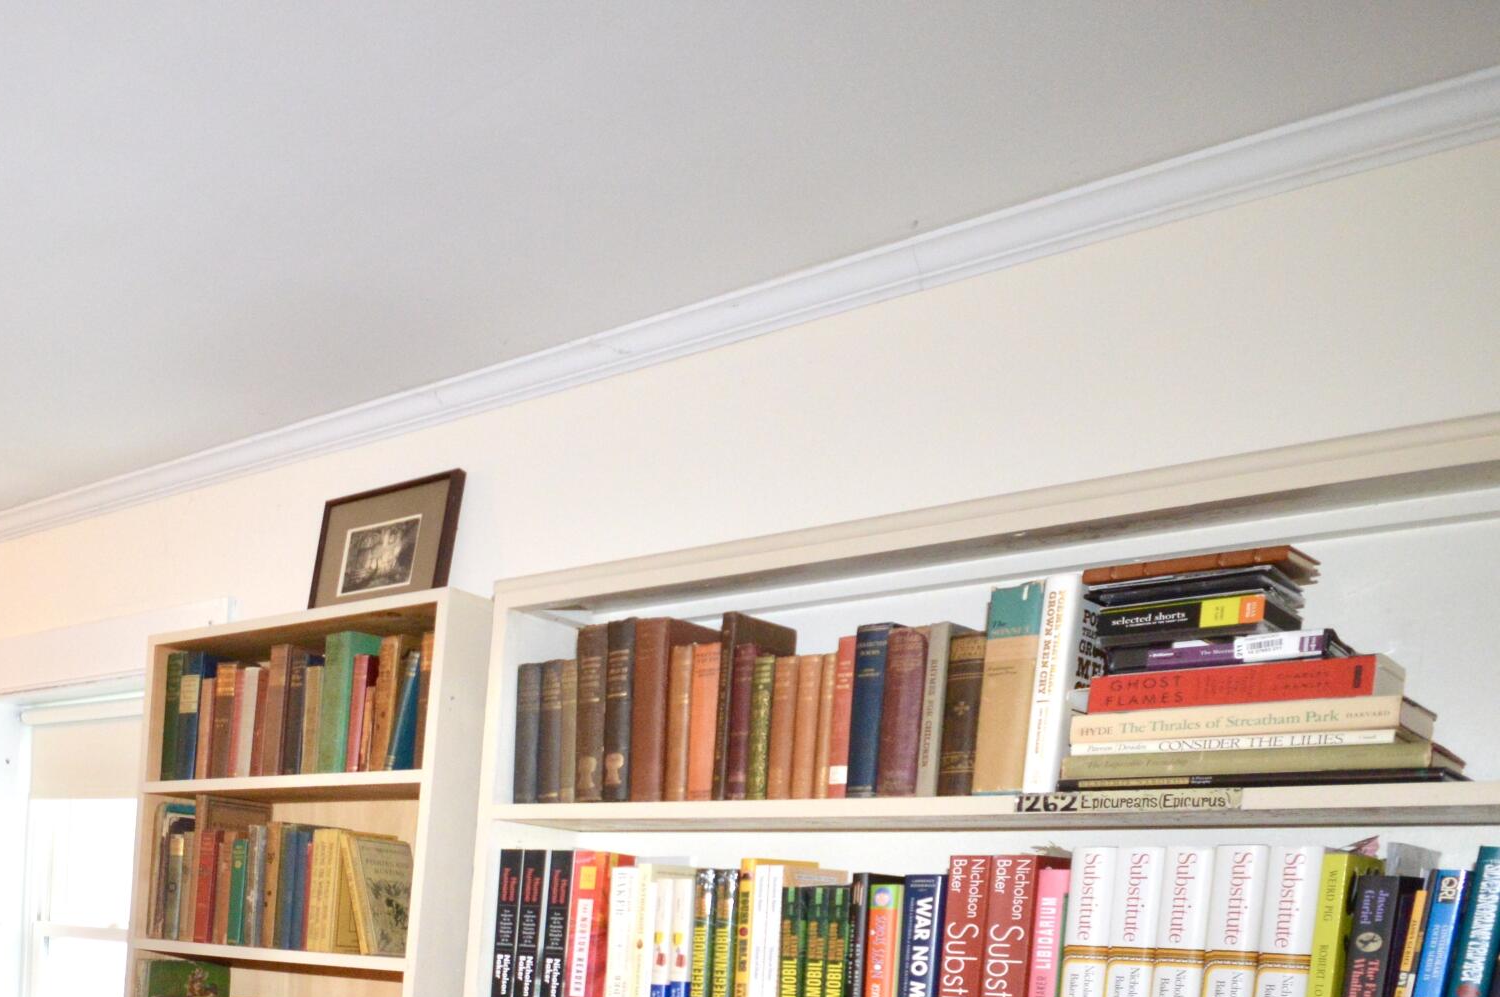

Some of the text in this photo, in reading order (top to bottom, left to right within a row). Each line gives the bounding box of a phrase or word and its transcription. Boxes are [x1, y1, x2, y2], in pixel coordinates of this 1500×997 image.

[1111, 613, 1152, 626] selected
[1154, 611, 1186, 623] shorts
[1038, 591, 1057, 695] GROWN MEN CRY
[1105, 692, 1185, 707] FLAMES
[1109, 675, 1182, 691] GHOST
[1080, 710, 1391, 737] HYDE The Thrales of Streatham Park HARVARD
[921, 720, 932, 768] CHILDREN
[1158, 738, 1240, 751] CONSIDER
[1250, 736, 1284, 747] THE
[1290, 734, 1344, 745] LILIES
[1017, 794, 1078, 812] 1262
[1080, 794, 1158, 810] Epicureans
[951, 858, 968, 893] Baker
[967, 858, 986, 918] Nicholson
[995, 859, 1012, 894] Baker
[1011, 859, 1031, 920] Nicholson
[1325, 870, 1338, 901] WEIRD
[1437, 876, 1458, 902] QRL
[1077, 853, 1101, 941] Substitute
[1123, 853, 1150, 943] Substitute
[1169, 852, 1196, 944] Substitute
[1224, 852, 1253, 946] Substitute
[1275, 853, 1306, 949] Substitute
[1323, 905, 1334, 922] PIG
[1359, 890, 1376, 924] Guriel
[1374, 890, 1390, 922] Jason
[914, 897, 933, 941] WAR
[523, 956, 533, 997] Nicholson
[544, 958, 552, 983] Baker
[910, 946, 928, 977] NO
[1315, 944, 1329, 980] ROBERT
[1366, 958, 1380, 980] The
[1068, 973, 1079, 997] Baker
